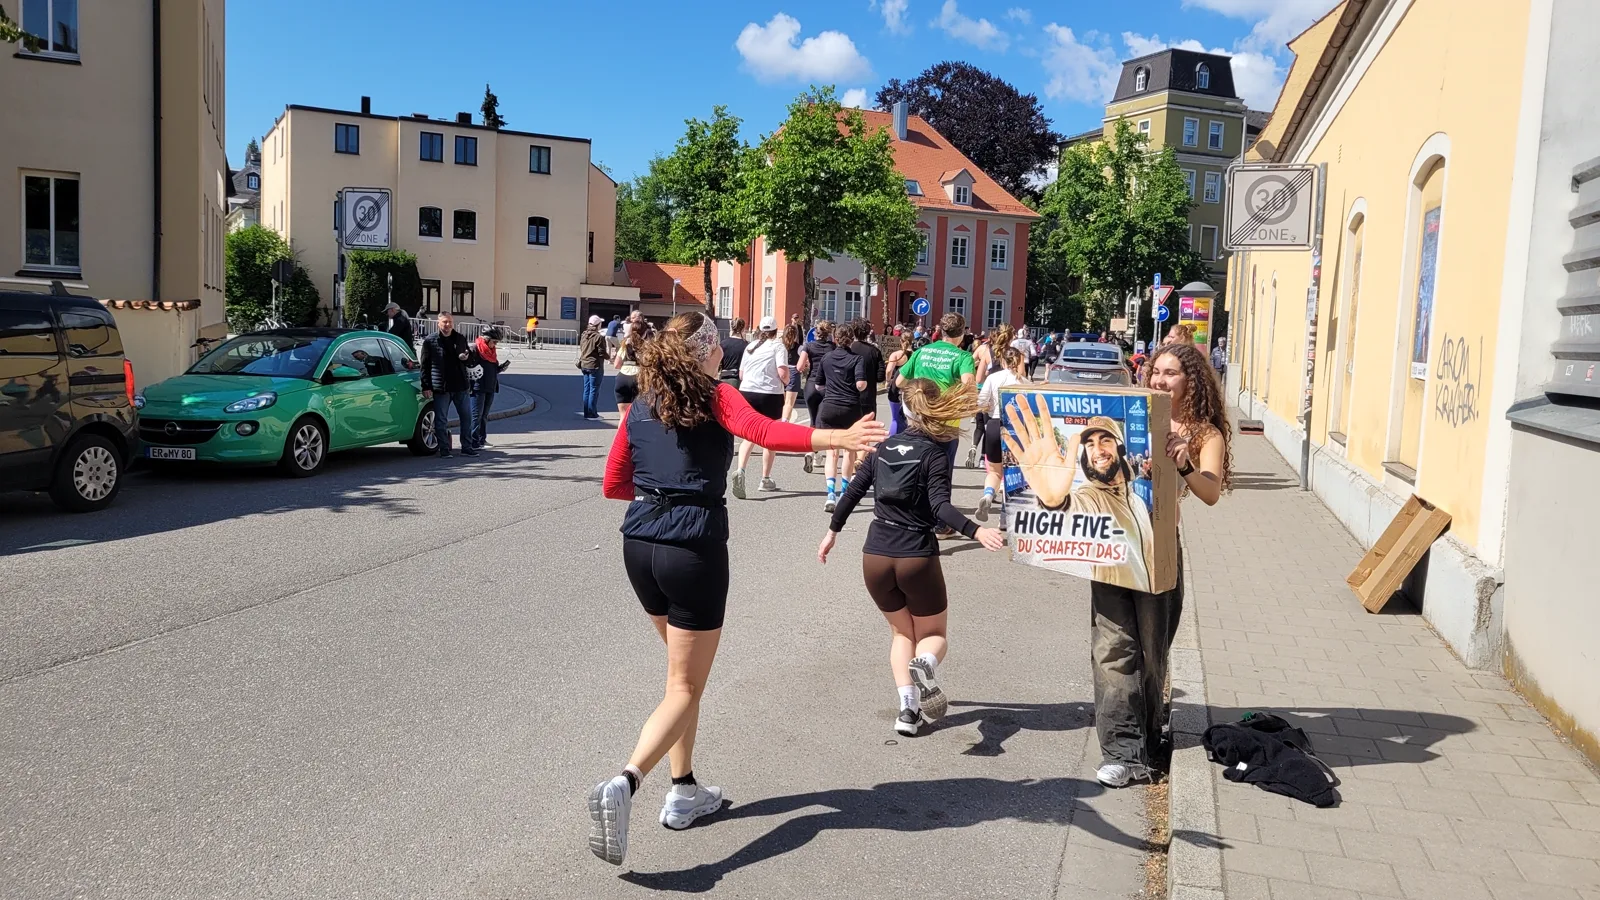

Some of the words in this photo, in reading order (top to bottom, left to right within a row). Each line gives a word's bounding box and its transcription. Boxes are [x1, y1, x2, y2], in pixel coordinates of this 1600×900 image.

[1255, 188, 1286, 212] 30
[358, 206, 376, 222] 30
[355, 233, 378, 243] ZONE
[1249, 228, 1289, 241] ZONE
[1052, 396, 1102, 415] FINISH
[152, 449, 164, 458] ER
[168, 449, 180, 458] MY
[181, 449, 192, 459] 80
[1014, 510, 1065, 536] HIGH
[1017, 538, 1033, 553] DU
[1035, 539, 1093, 557] SCHAFFST
[1095, 543, 1127, 562] DAS!
